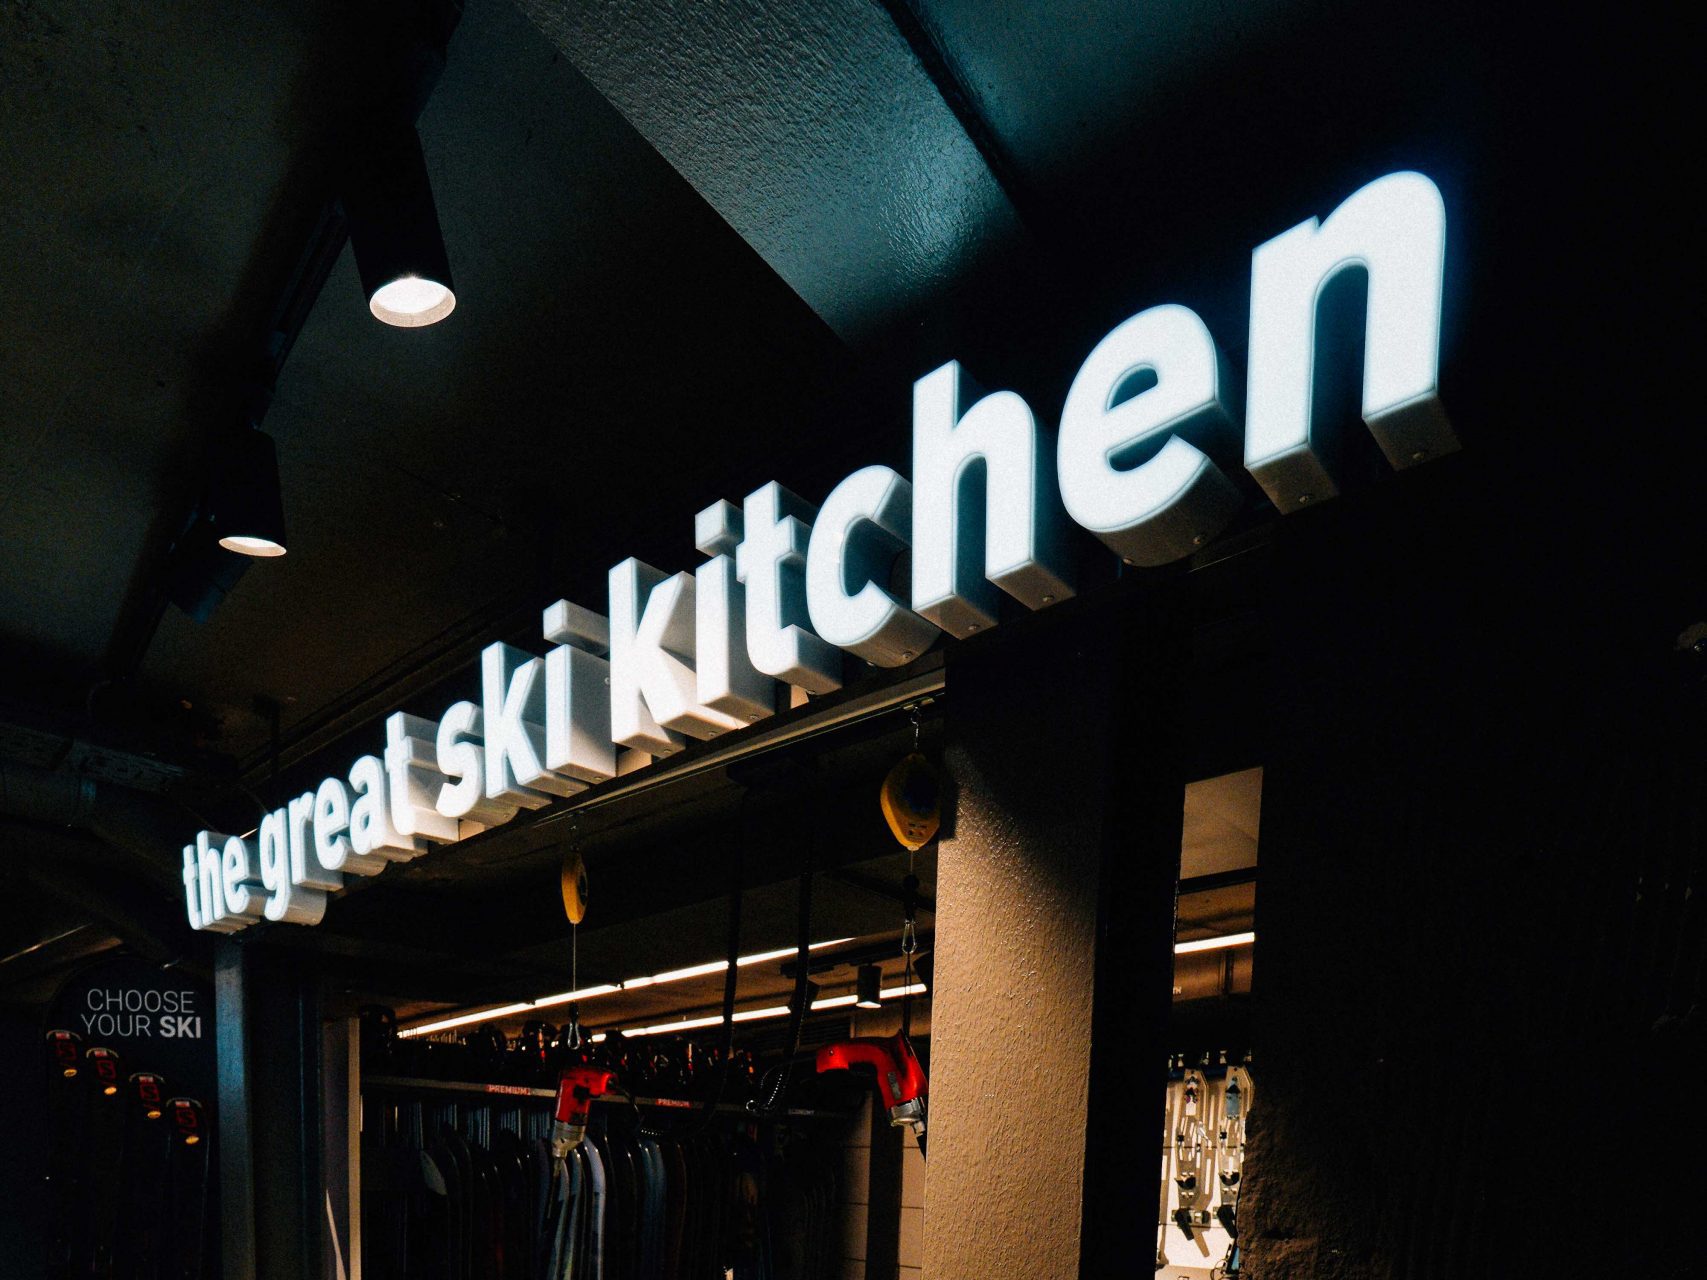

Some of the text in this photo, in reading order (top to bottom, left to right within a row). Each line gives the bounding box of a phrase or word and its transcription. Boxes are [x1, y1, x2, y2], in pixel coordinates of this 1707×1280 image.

[182, 171, 1446, 931] the great ski kitchen
[86, 988, 196, 1014] CHOOSE
[80, 1013, 203, 1039] YOUR SKI
